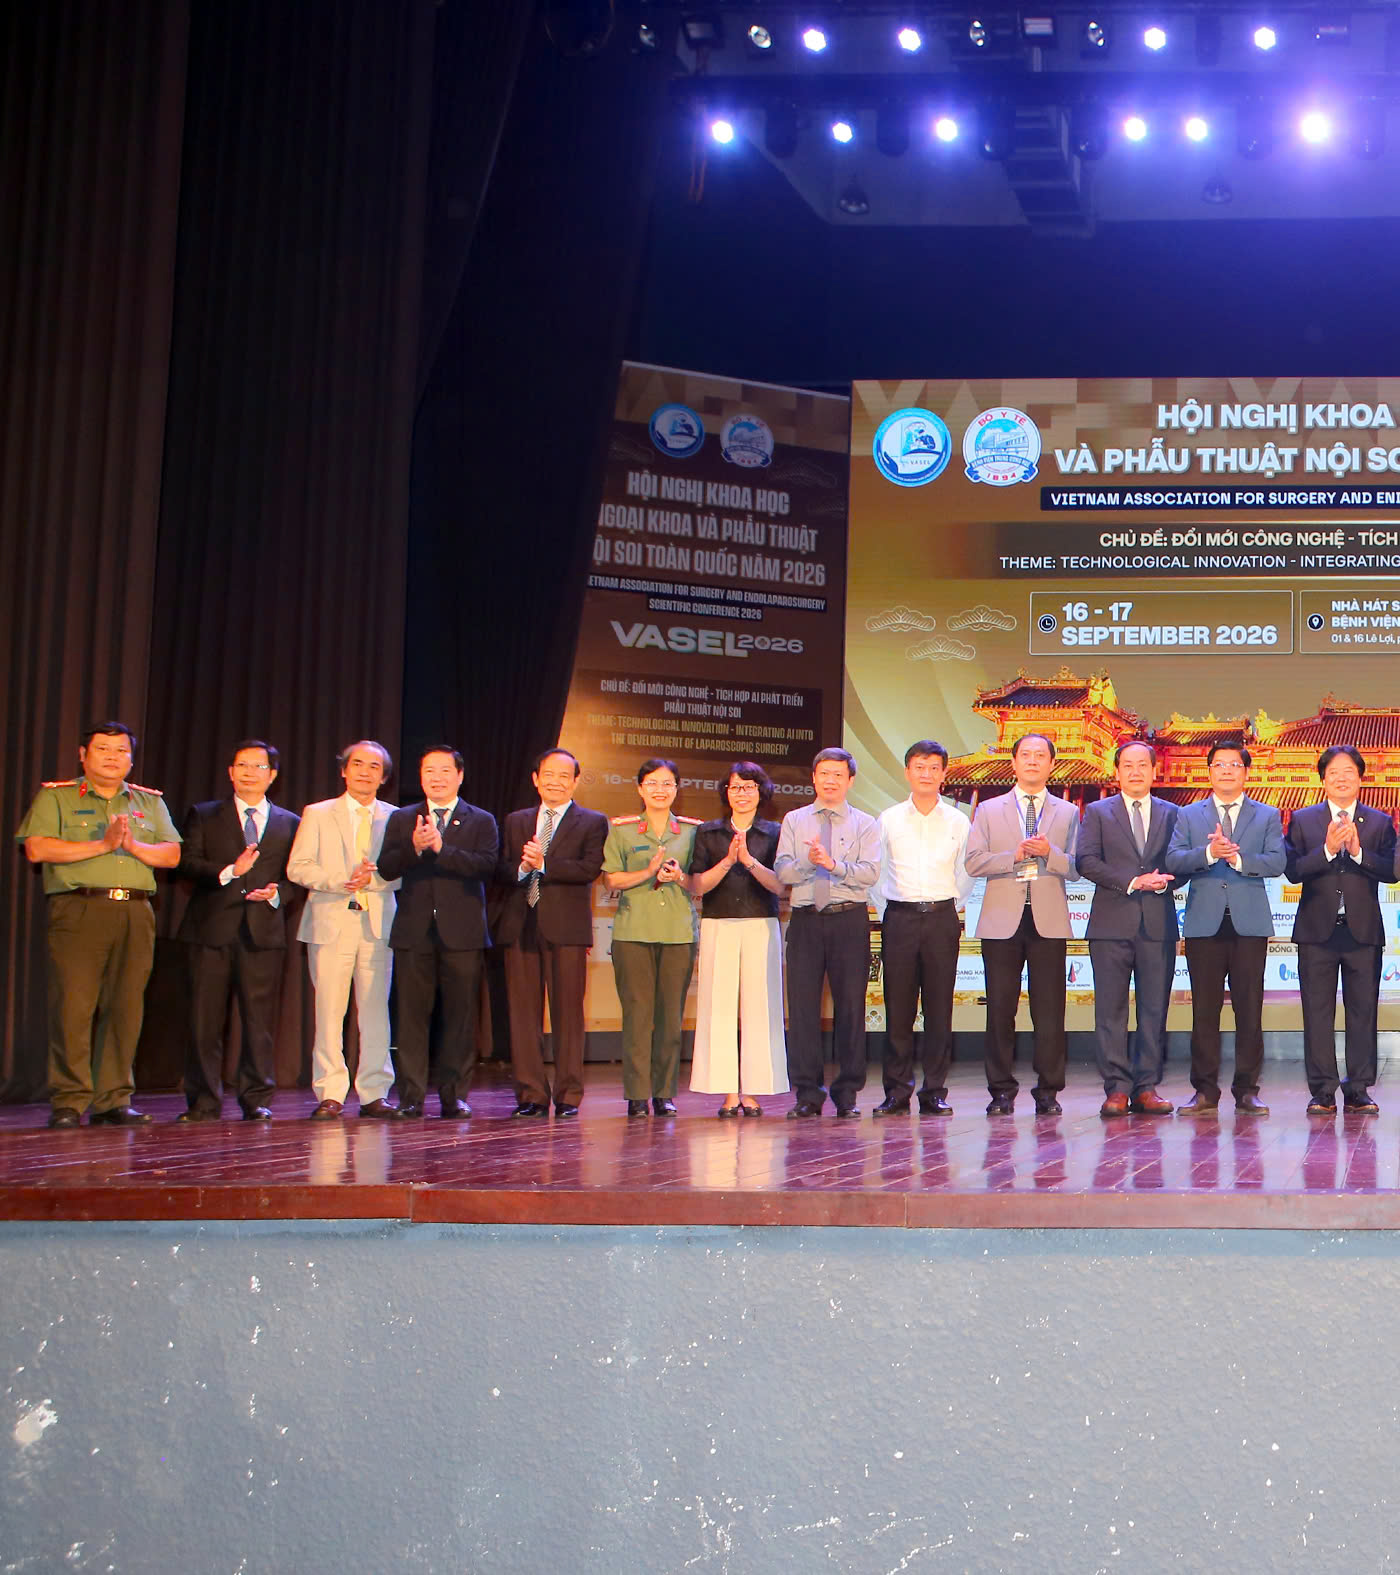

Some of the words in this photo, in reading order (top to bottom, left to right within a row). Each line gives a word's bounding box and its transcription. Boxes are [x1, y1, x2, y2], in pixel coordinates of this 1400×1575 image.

[1157, 398, 1212, 434] HỘI
[1219, 403, 1297, 434] NGHỊ
[1304, 403, 1395, 428] KHOA
[1054, 442, 1099, 473] VÀ
[1103, 437, 1189, 473] PHẪU
[1195, 441, 1299, 478] THUẬT
[1305, 441, 1360, 478] NỘI
[706, 482, 752, 510] KHOA
[1050, 492, 1120, 506] VIETNAM
[1122, 492, 1231, 505] ASSOCIATION
[1235, 492, 1265, 505] FOR
[1268, 491, 1337, 505] SURGERY
[1339, 491, 1373, 505] AND
[647, 508, 693, 537] KHOA
[696, 513, 719, 540] VÀ
[1099, 528, 1137, 547] CHỦ
[1139, 527, 1168, 547] ĐỀ:
[1170, 527, 1202, 547] ĐỔI
[1205, 528, 1239, 547] MỚI
[1242, 528, 1294, 547] CÔNG
[1296, 528, 1345, 549] NGHỆ
[1357, 528, 1398, 546] TÍCH
[613, 540, 642, 566] SOI
[783, 560, 826, 586] 2026
[999, 556, 1056, 569] THEME:
[1060, 555, 1190, 569] TECHNOLOGICAL
[1193, 555, 1286, 568] INNOVATION
[619, 578, 673, 594] ASSOCIATION
[674, 584, 689, 596] FOR
[690, 585, 725, 600] SURGERY
[726, 590, 743, 602] AND
[744, 591, 826, 610] ENDOLAPAROSURGERY
[1331, 597, 1361, 612] NHÀ
[1362, 597, 1390, 612] HÁT
[649, 598, 691, 614] SCIENTIFIC
[692, 602, 740, 618] CONFERENCE
[740, 608, 762, 620] 2026
[1062, 601, 1089, 622] 16
[1108, 601, 1133, 622] 17
[1331, 613, 1368, 630] BỆNH
[610, 620, 748, 658] VASEL
[737, 633, 804, 654] 2026
[1061, 625, 1210, 646] SEPTEMBER
[1215, 625, 1278, 645] 2026
